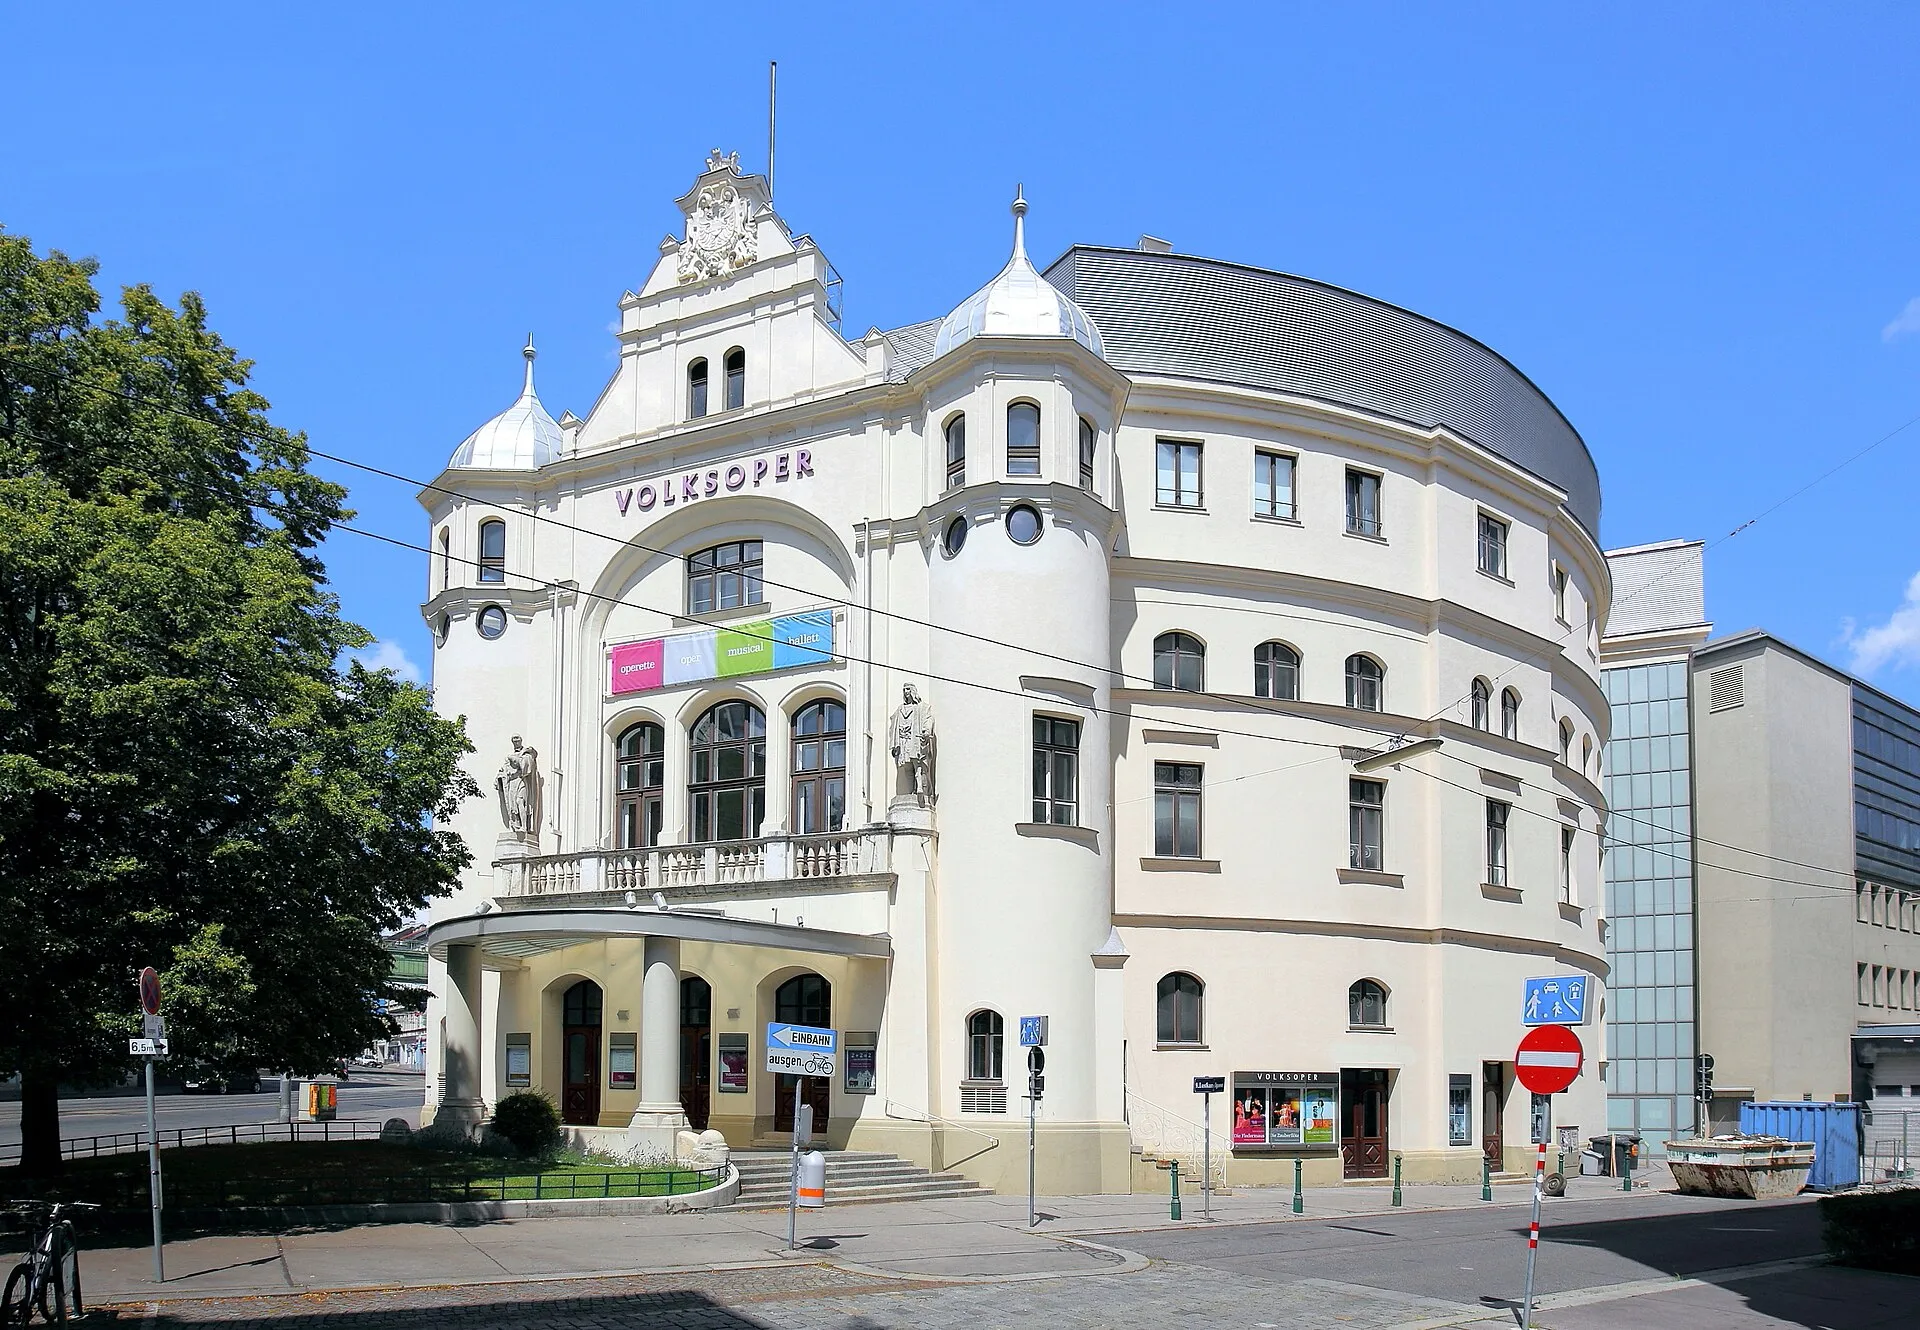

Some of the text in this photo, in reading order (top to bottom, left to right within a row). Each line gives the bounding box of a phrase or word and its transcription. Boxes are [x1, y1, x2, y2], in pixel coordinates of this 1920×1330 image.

[615, 449, 813, 513] VOLKSOPER
[787, 633, 820, 646] ballett
[727, 642, 764, 657] musical
[680, 654, 701, 666] oper
[620, 660, 655, 675] operette
[792, 1032, 831, 1046] EINBAHN
[769, 1055, 805, 1069] ausgen.
[1257, 1073, 1319, 1081] VOLKSOPER
